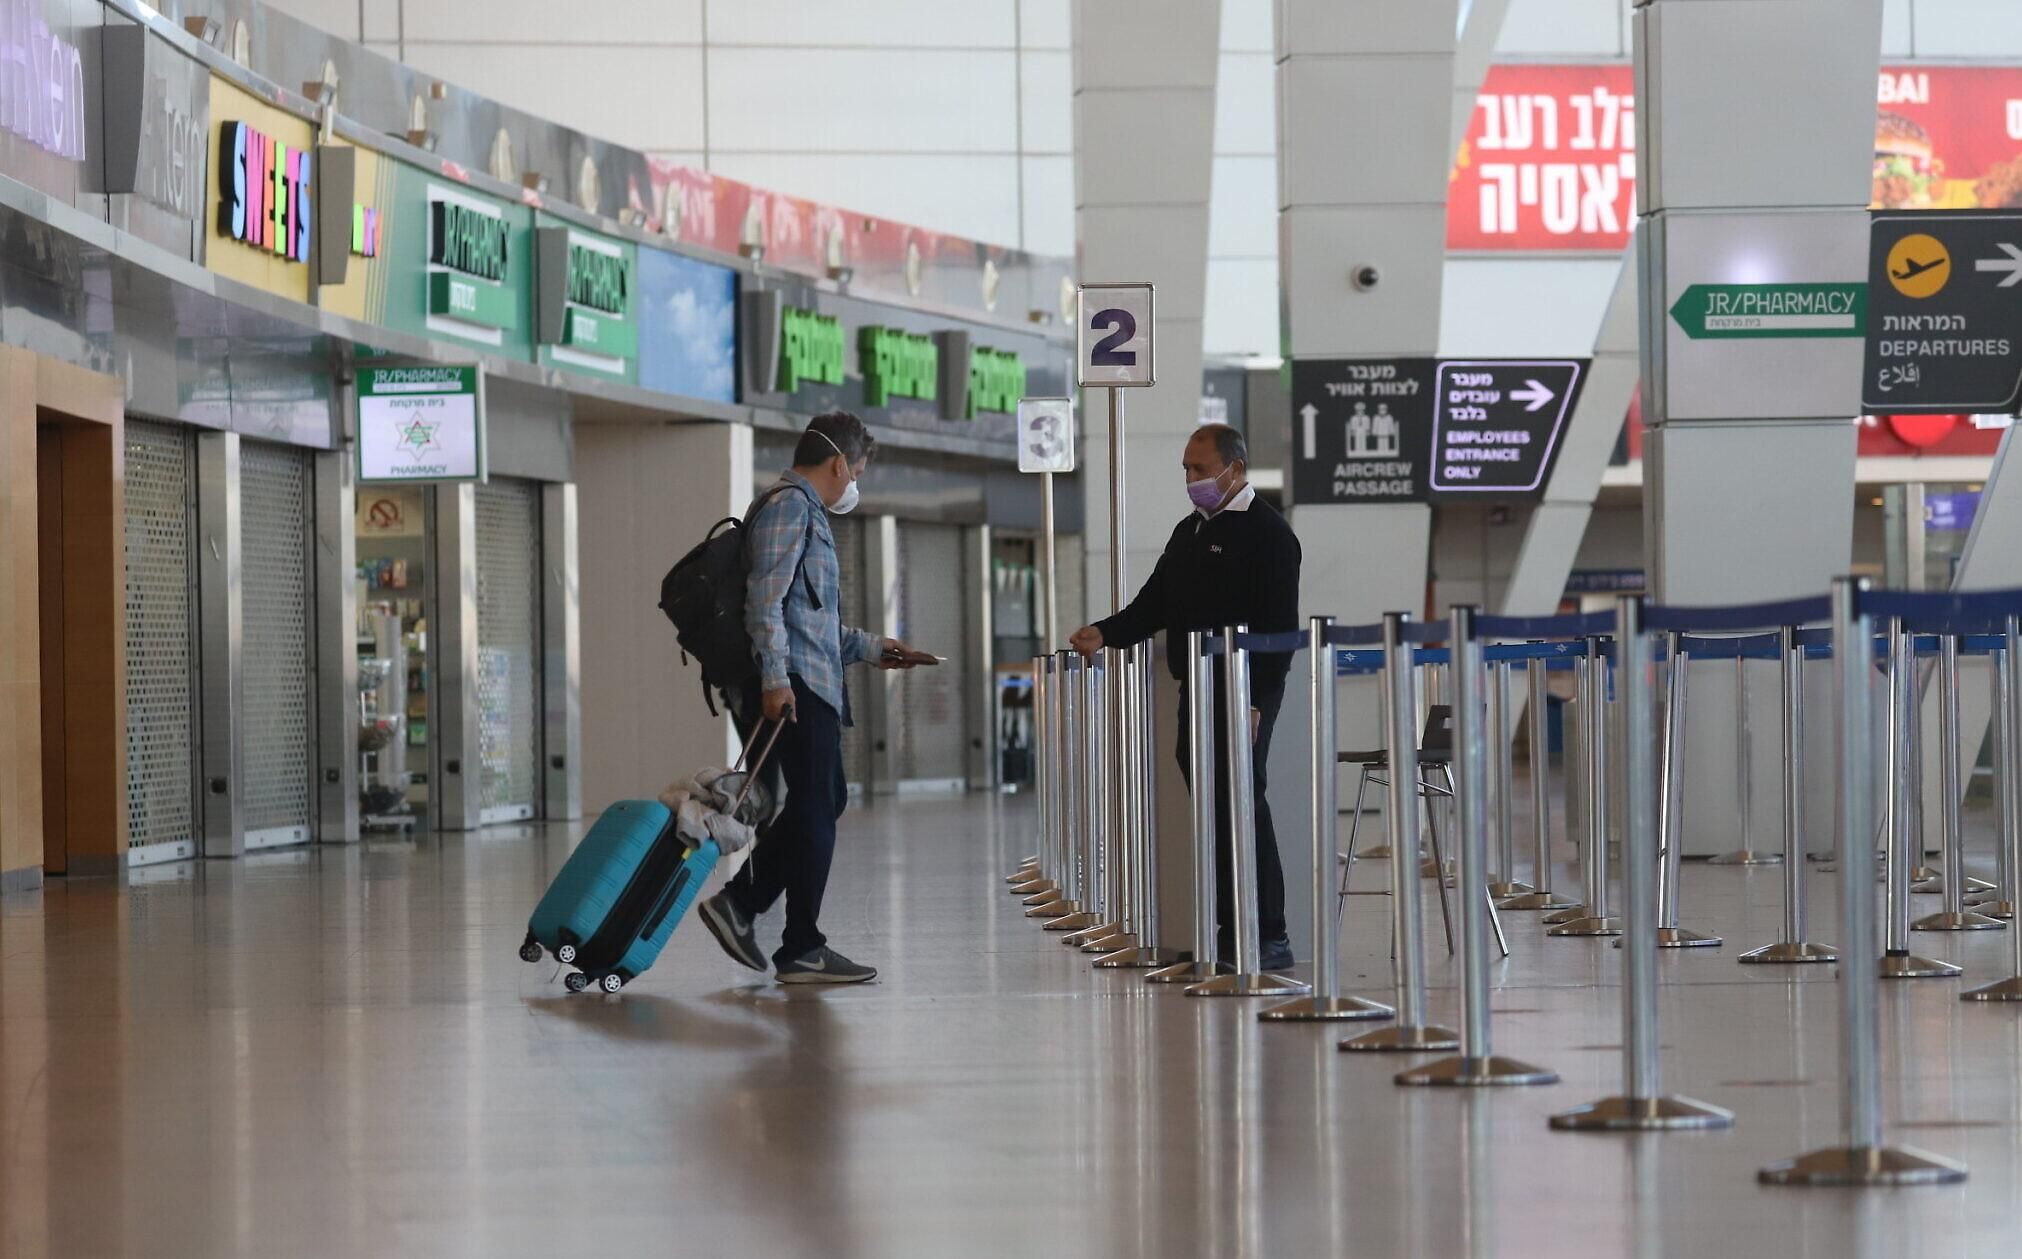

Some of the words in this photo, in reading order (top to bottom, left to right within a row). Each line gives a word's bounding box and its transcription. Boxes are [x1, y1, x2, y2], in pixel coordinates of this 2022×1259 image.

[1877, 73, 1929, 104] BAI
[1476, 94, 1558, 150] רעב
[229, 120, 311, 263] SWEETS
[1705, 292, 1856, 315] JR/PHARMACY
[1883, 315, 1966, 331] המראות
[1090, 308, 1136, 366] 2
[1880, 339, 2010, 356] DEPARTURES
[374, 368, 462, 383] JR/PHARMACY
[1347, 365, 1396, 380] מעבר
[1450, 373, 1493, 387] מעבר
[1325, 381, 1366, 397] אוויר
[1370, 378, 1419, 396] לצוות
[1449, 390, 1500, 404] עובדים
[1449, 405, 1487, 420] בלבד
[1030, 415, 1064, 458] 3
[1446, 430, 1531, 444] EMPLOYEES
[1445, 448, 1521, 462] ENTRANCE
[391, 464, 447, 475] PHARMACY
[1334, 462, 1413, 477] AIRCREW
[1444, 466, 1481, 479] ONLY
[1333, 480, 1414, 496] PASSAGE
